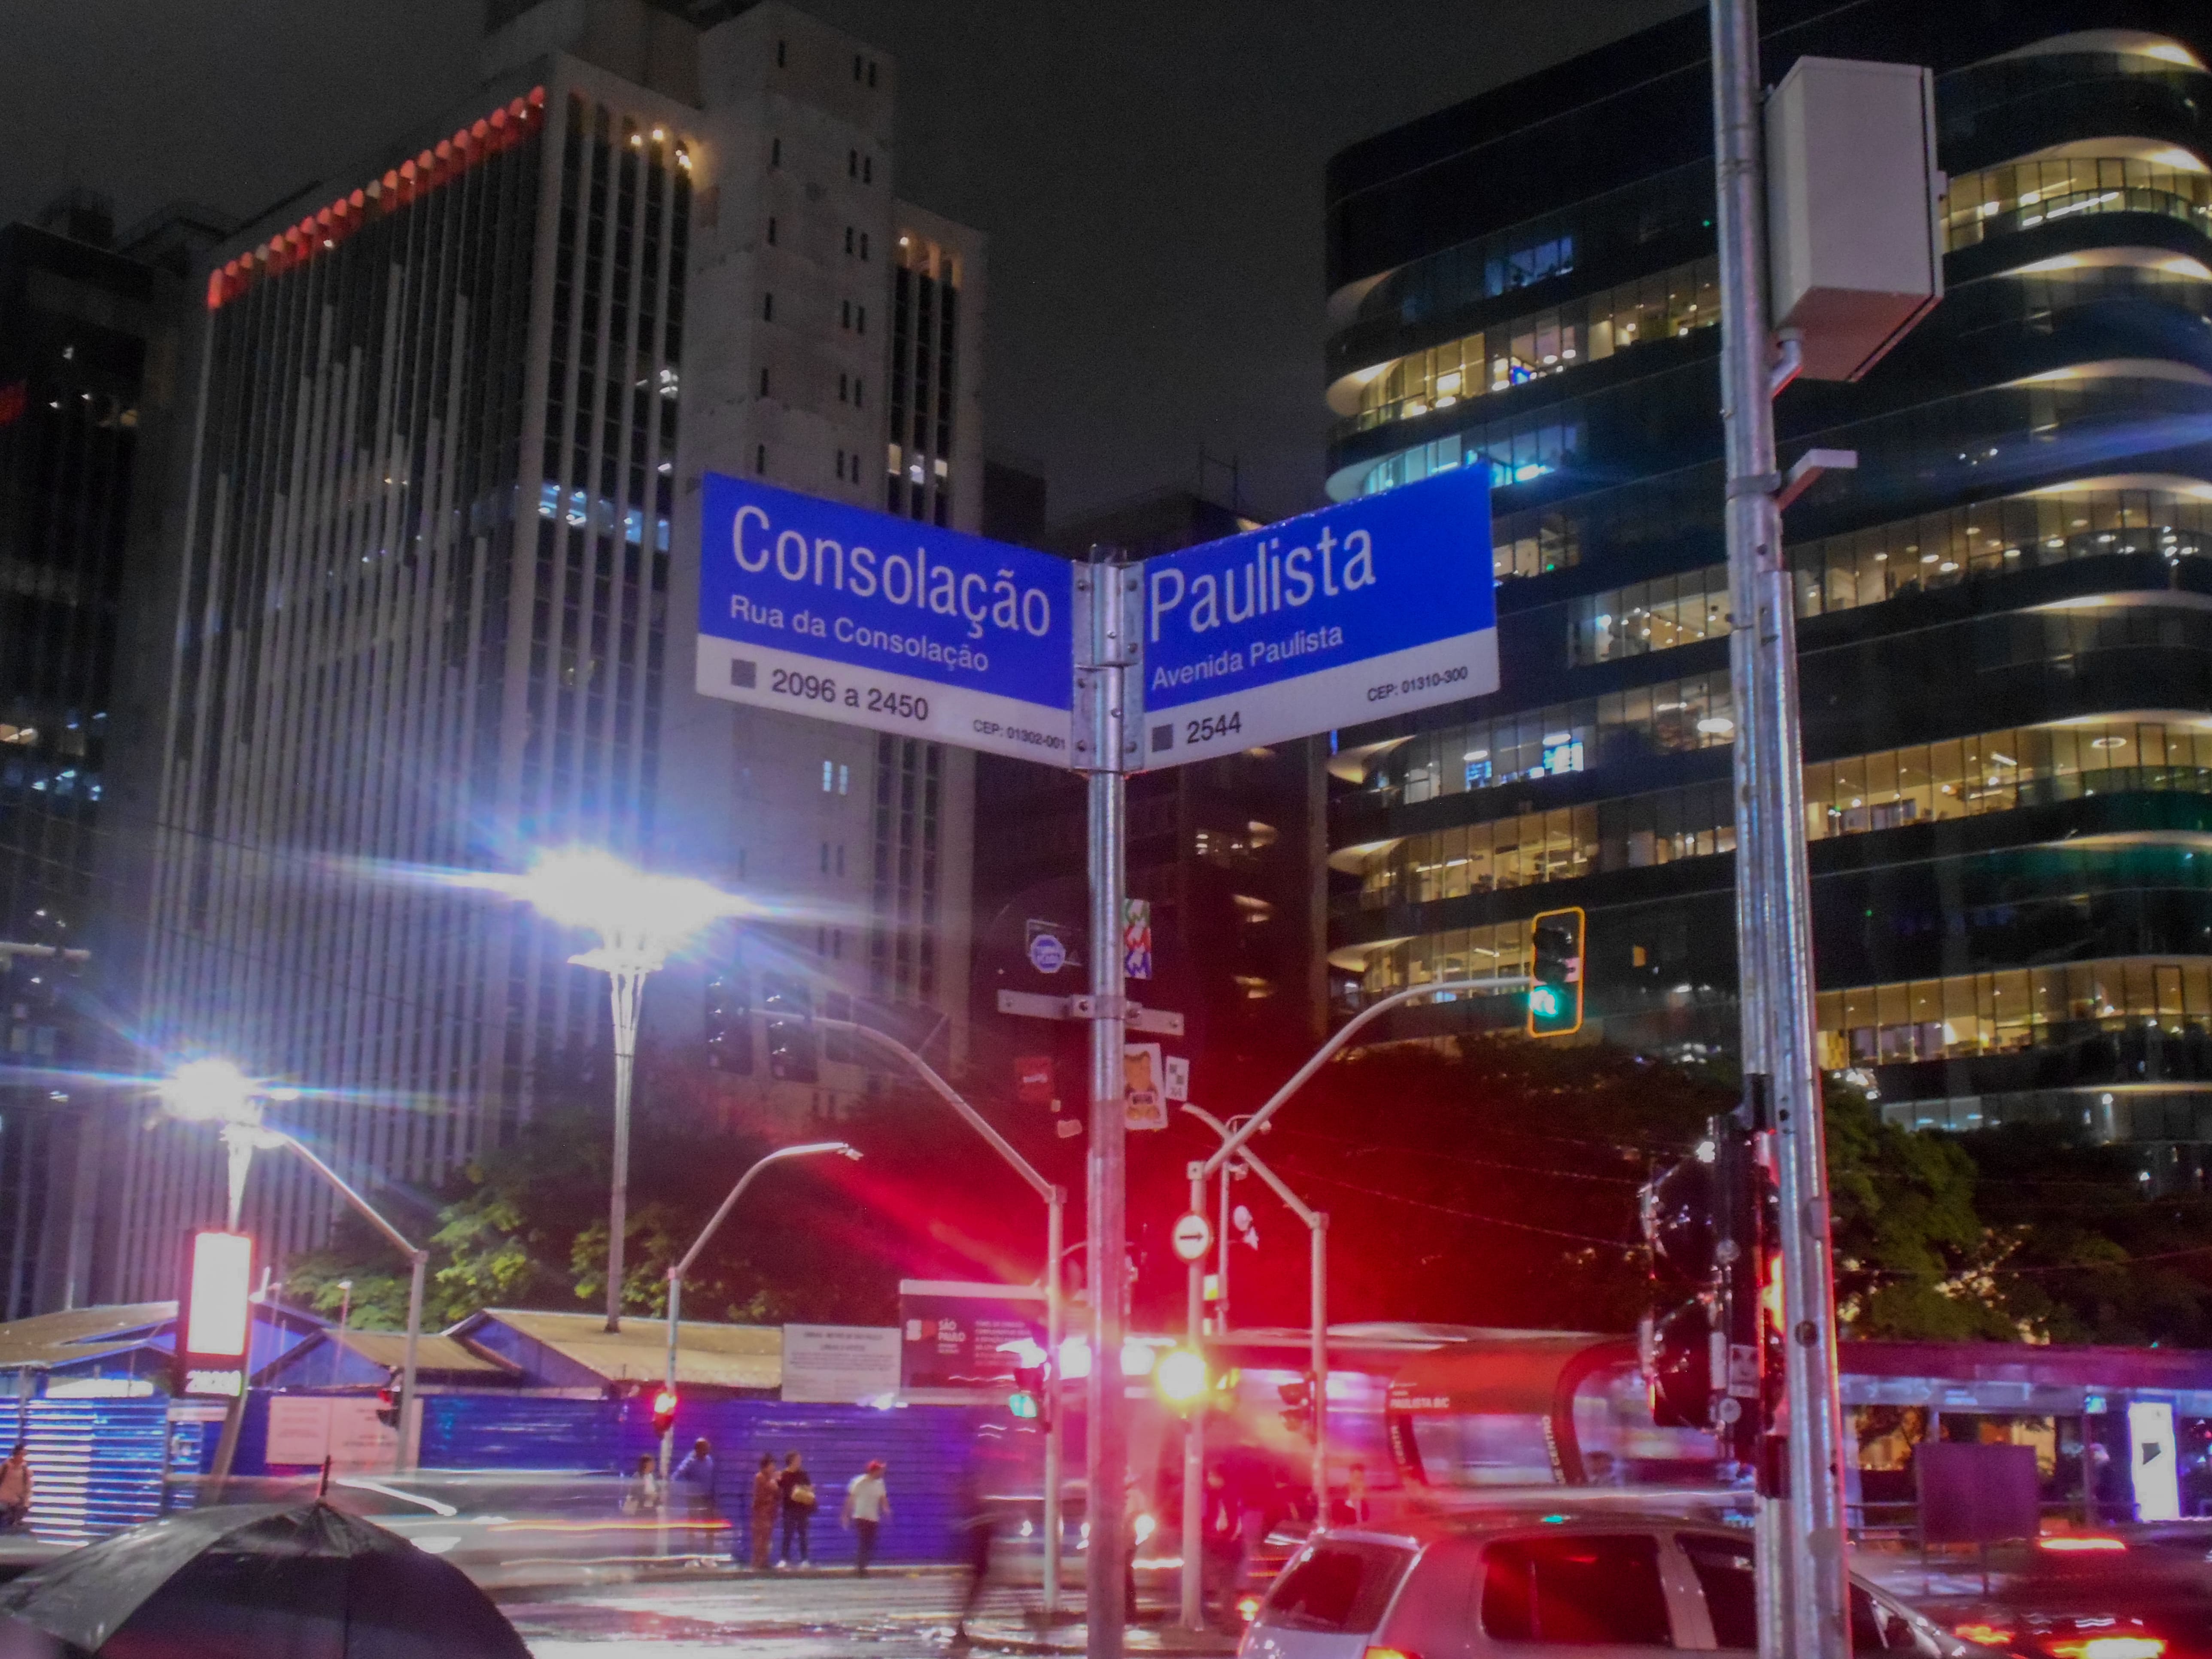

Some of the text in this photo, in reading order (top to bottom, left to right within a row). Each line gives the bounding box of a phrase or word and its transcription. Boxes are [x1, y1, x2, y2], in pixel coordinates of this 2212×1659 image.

[733, 505, 1051, 639] Consolação
[1151, 526, 1376, 643] Paulista
[730, 594, 989, 672] Rua da Consolação
[1152, 626, 1343, 690] Avenida Paulista
[772, 669, 929, 721] 2096 a 2450
[1367, 666, 1468, 701] CEP: 01310-300
[973, 719, 1004, 737] CEP:
[1187, 711, 1241, 745] 2544
